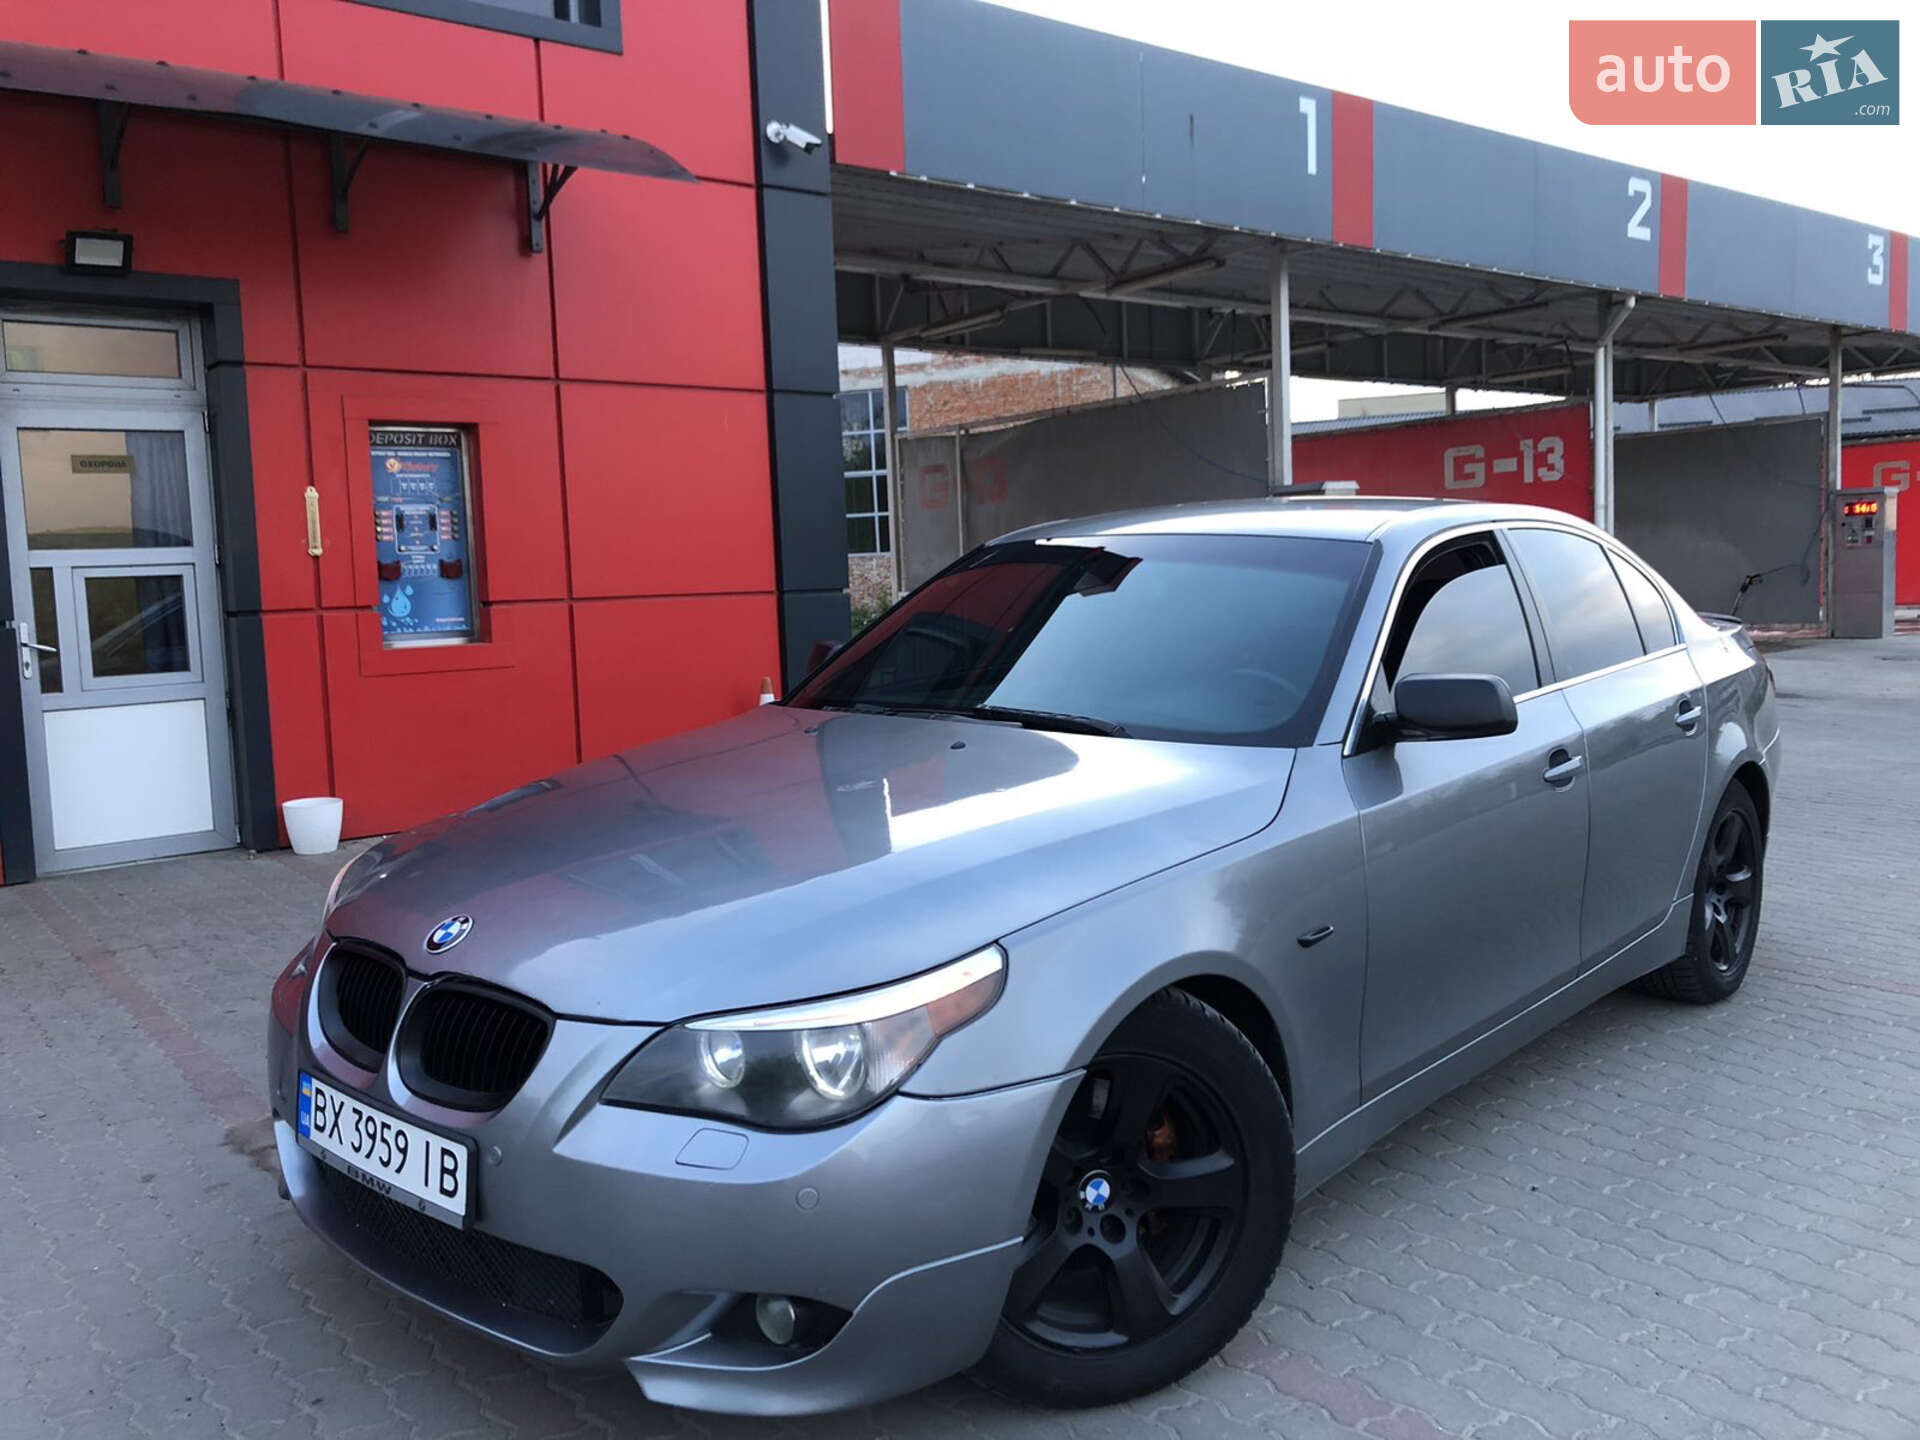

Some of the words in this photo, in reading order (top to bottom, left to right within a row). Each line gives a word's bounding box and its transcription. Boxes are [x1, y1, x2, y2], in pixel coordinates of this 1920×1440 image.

[1299, 95, 1317, 176] 1
[1627, 176, 1652, 241] 2
[1868, 233, 1884, 285] 3
[1443, 435, 1565, 490] G-13
[313, 1086, 345, 1146] BX
[350, 1107, 409, 1174] 3959
[424, 1140, 459, 1199] IB
